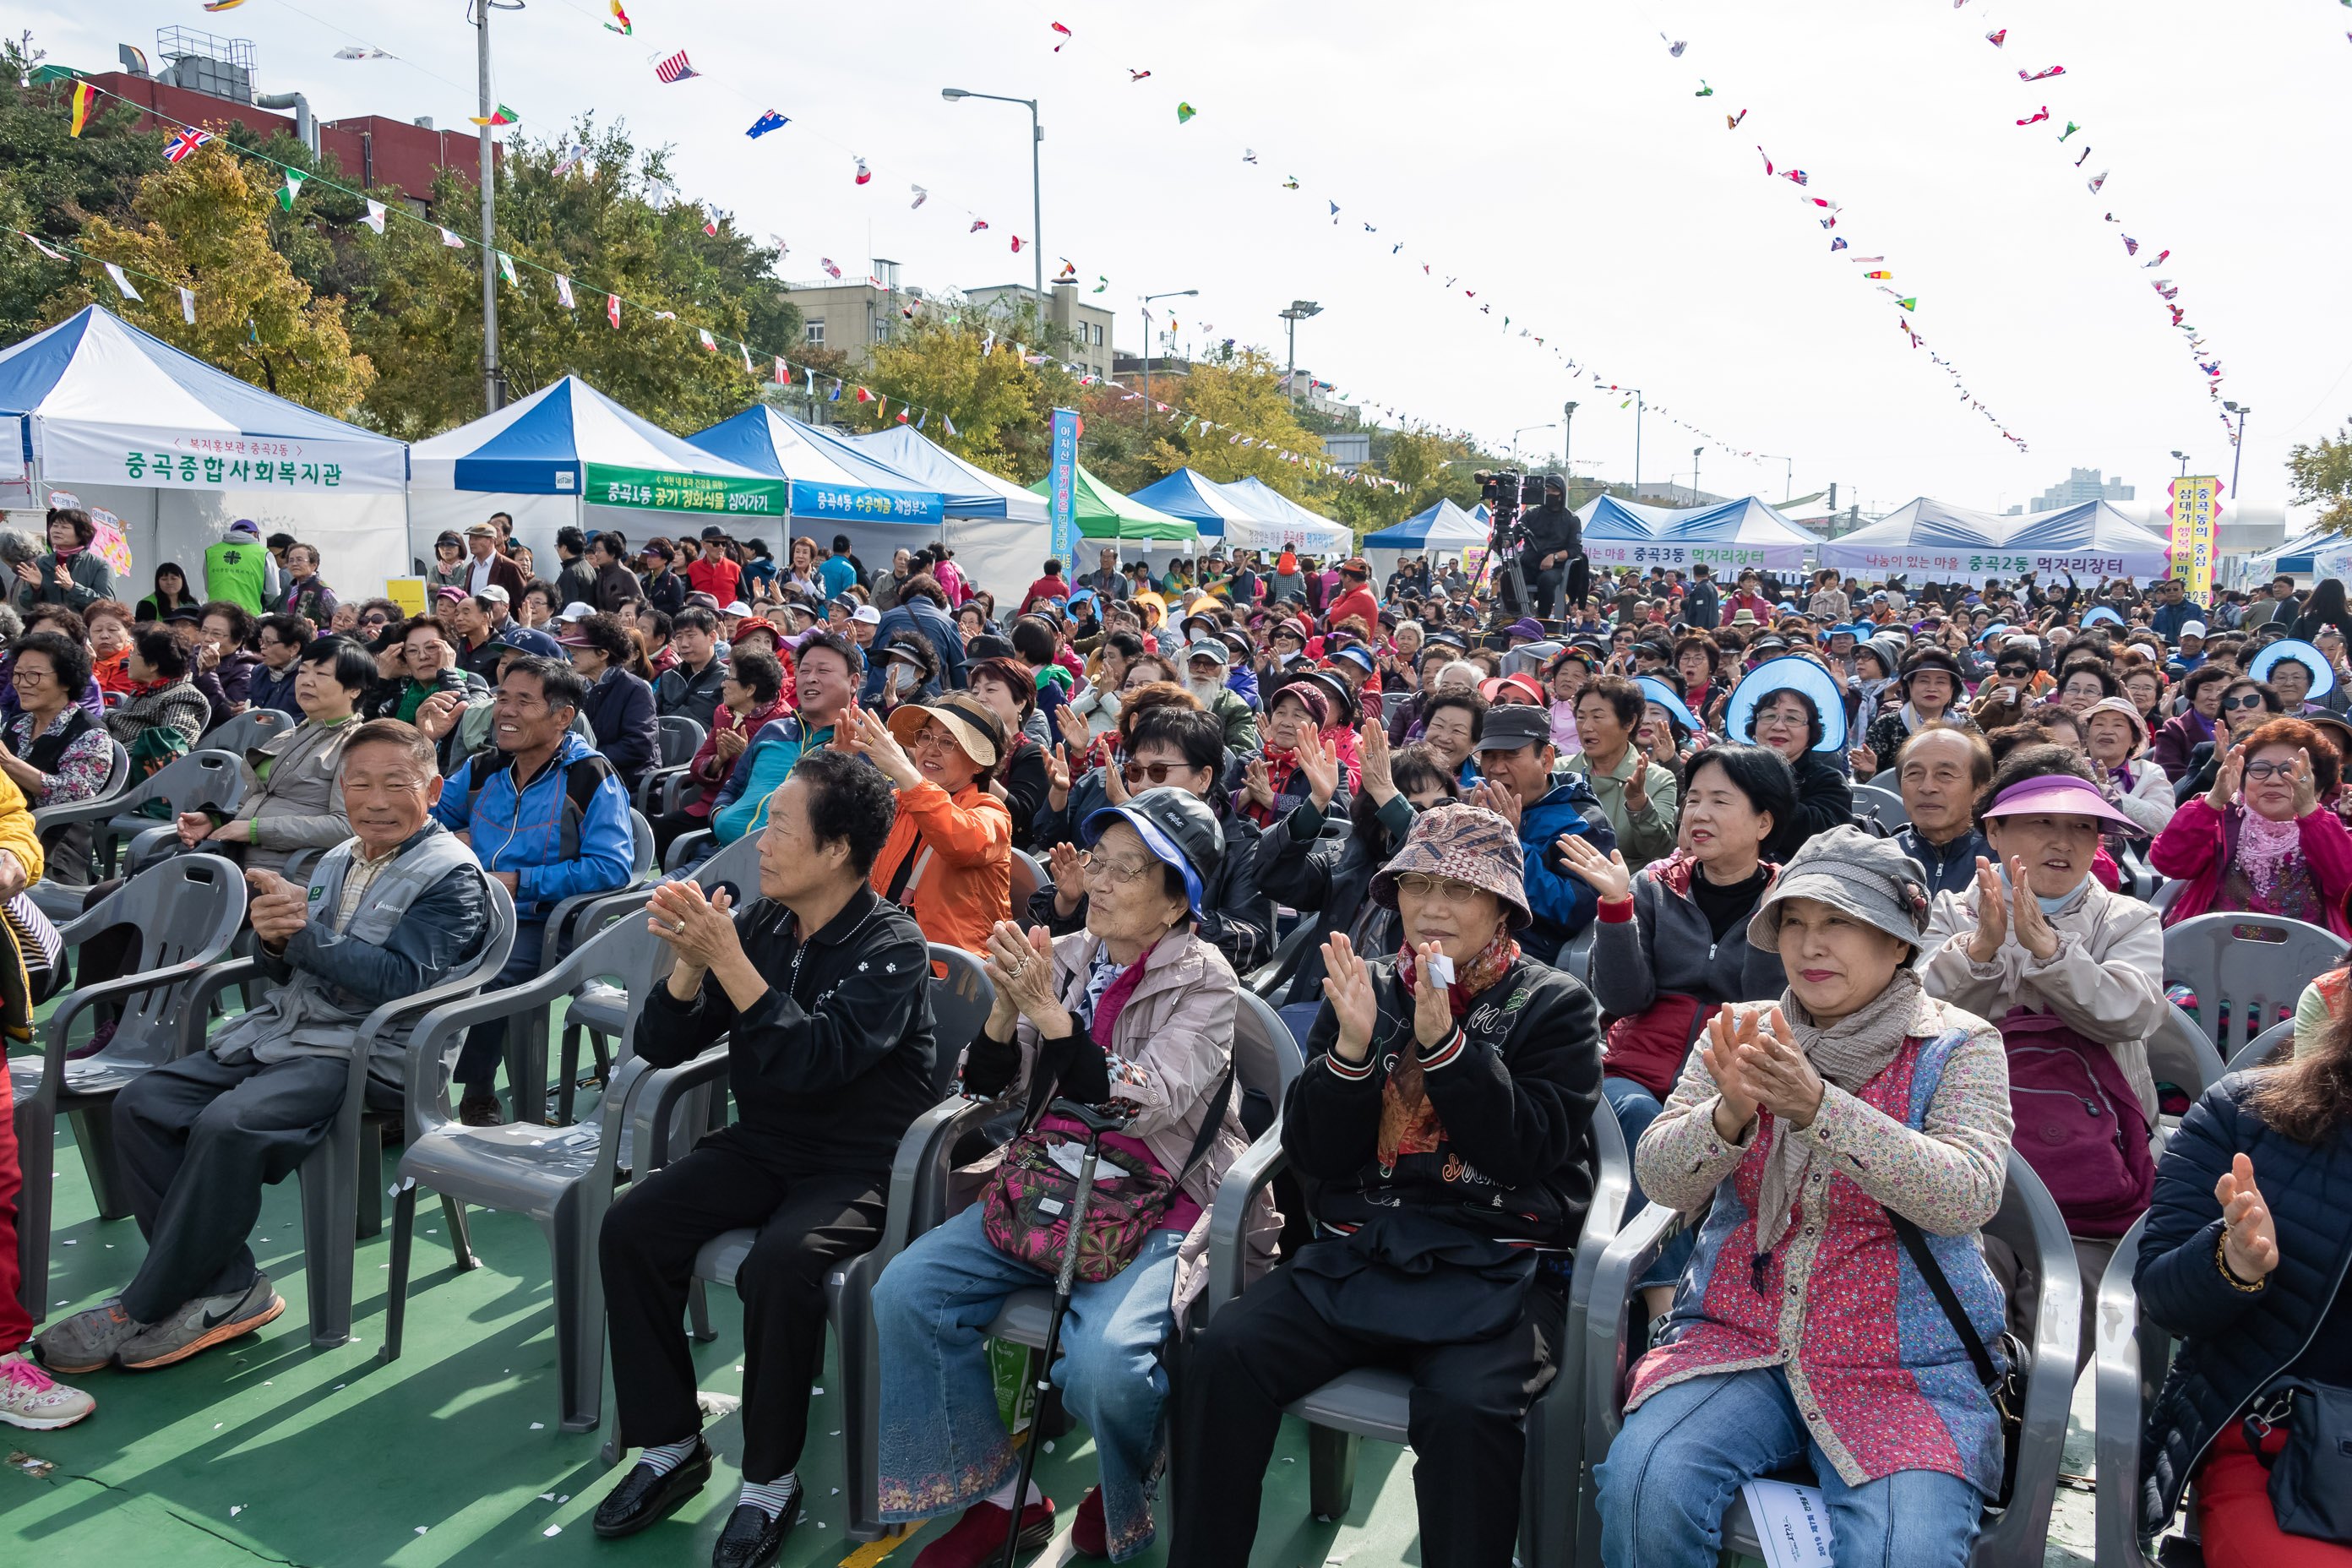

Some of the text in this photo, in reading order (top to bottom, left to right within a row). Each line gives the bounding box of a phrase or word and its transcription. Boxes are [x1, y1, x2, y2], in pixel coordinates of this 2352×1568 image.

[190, 438, 245, 454] 복지홍보관
[251, 444, 289, 456] 중곡2동
[1060, 425, 1071, 461] 아차산
[125, 452, 342, 487] 중곡종합사회복지관
[608, 482, 768, 511] 중곡1동 공기 정화식물 심어가기
[1058, 466, 1070, 512] 정기품은
[818, 492, 928, 515] 중곡4동 수공예품 체험부스
[2178, 489, 2193, 524] 삼대가
[2194, 488, 2210, 537] 중곡동의
[1056, 515, 1068, 550] 긴고랑
[1249, 529, 1335, 548] 정감있는 마을 중곡4동 먹거리장터
[2176, 526, 2191, 562] 행복한
[1605, 548, 1626, 561] 마을
[1633, 547, 1685, 563] 중곡3동
[1691, 548, 1764, 564] 먹거리장터
[1866, 553, 2123, 574] 나눔이 있는 마을 중곡2동 먹거리장터
[2193, 543, 2208, 567] 중심
[1807, 1515, 1818, 1533] 제7회
[1815, 1537, 1826, 1556] 2019
